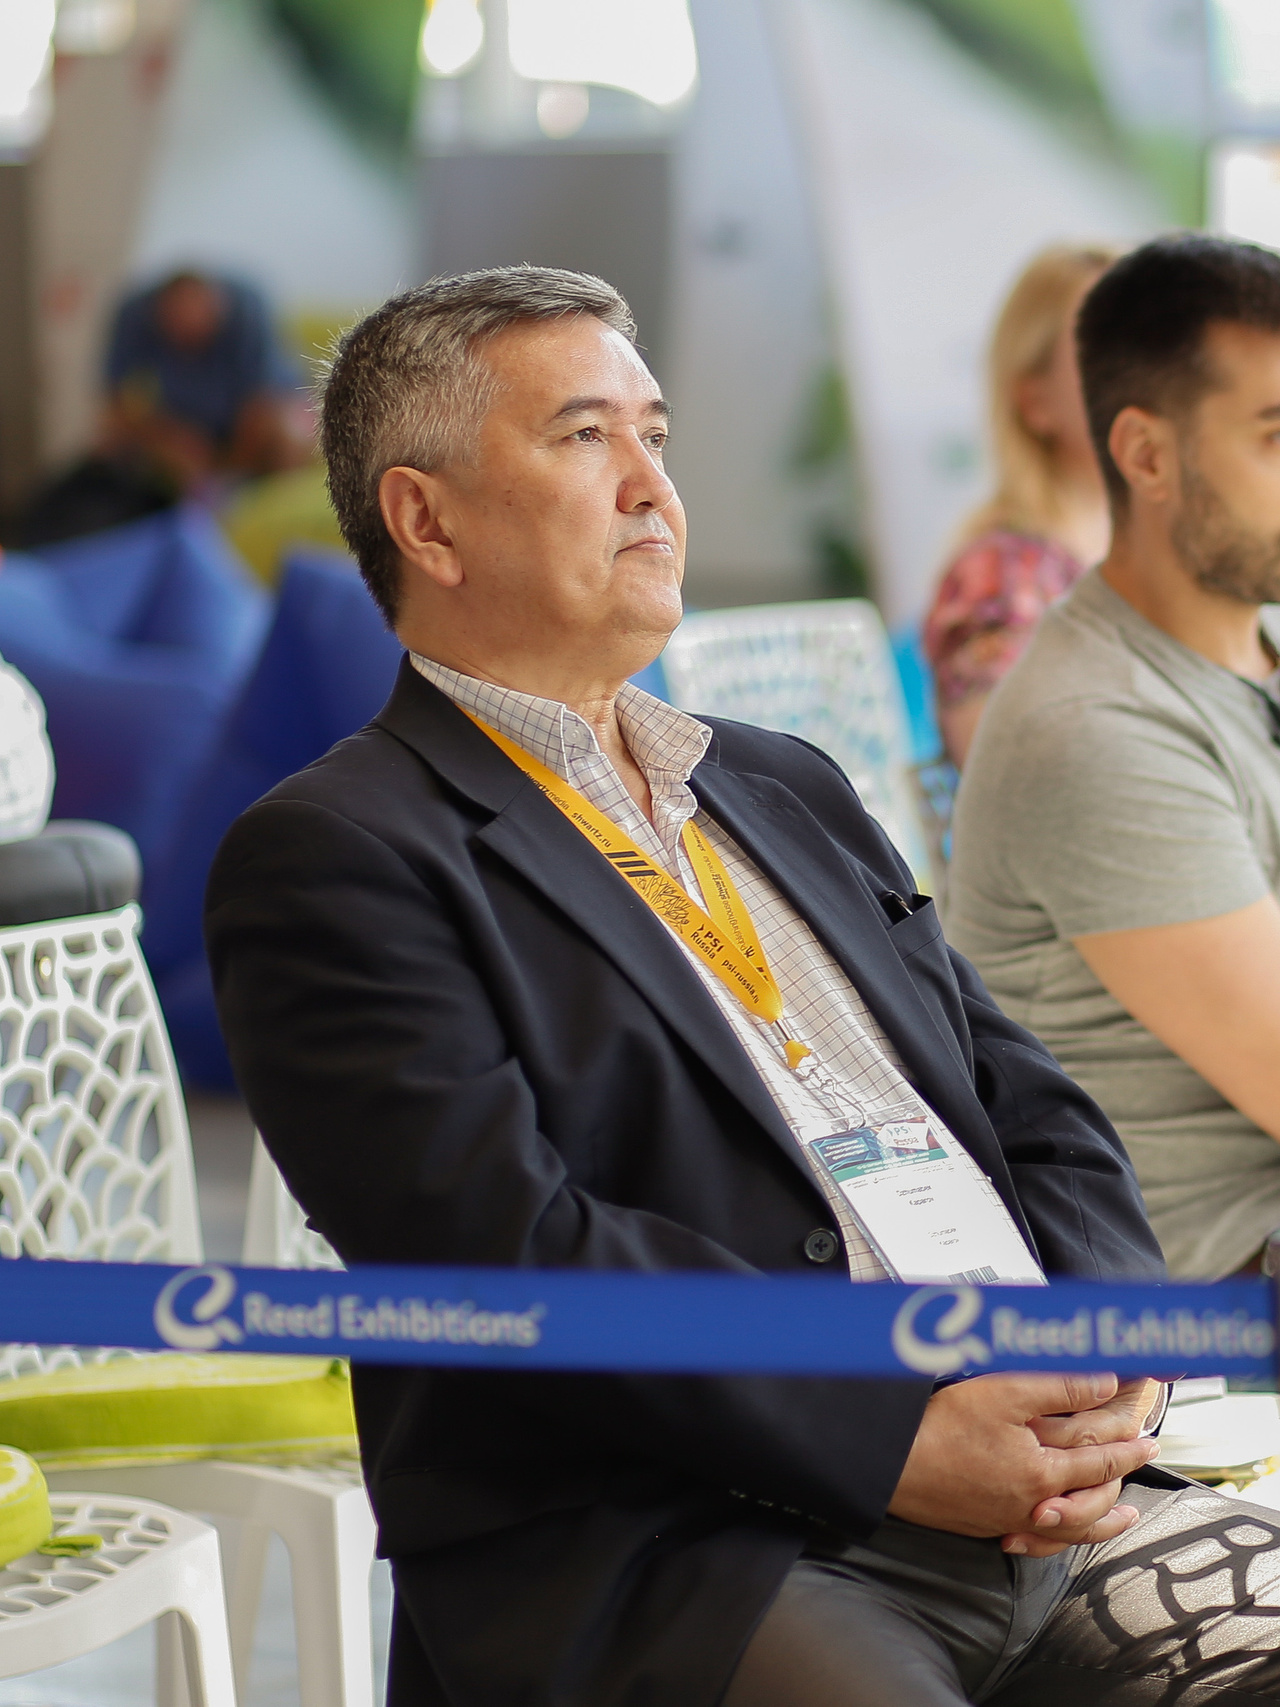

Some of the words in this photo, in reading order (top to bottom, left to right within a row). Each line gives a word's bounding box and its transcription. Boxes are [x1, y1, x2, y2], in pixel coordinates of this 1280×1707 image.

[571, 811, 612, 848] shwartz.ru
[689, 931, 716, 960] Russia
[704, 931, 724, 953] PSI
[721, 959, 760, 1004] psi-russia.ru
[243, 1292, 335, 1340] Reed
[337, 1294, 541, 1348] Exhibitions
[990, 1307, 1092, 1358] Reed
[1096, 1308, 1277, 1359] Exhibitio
